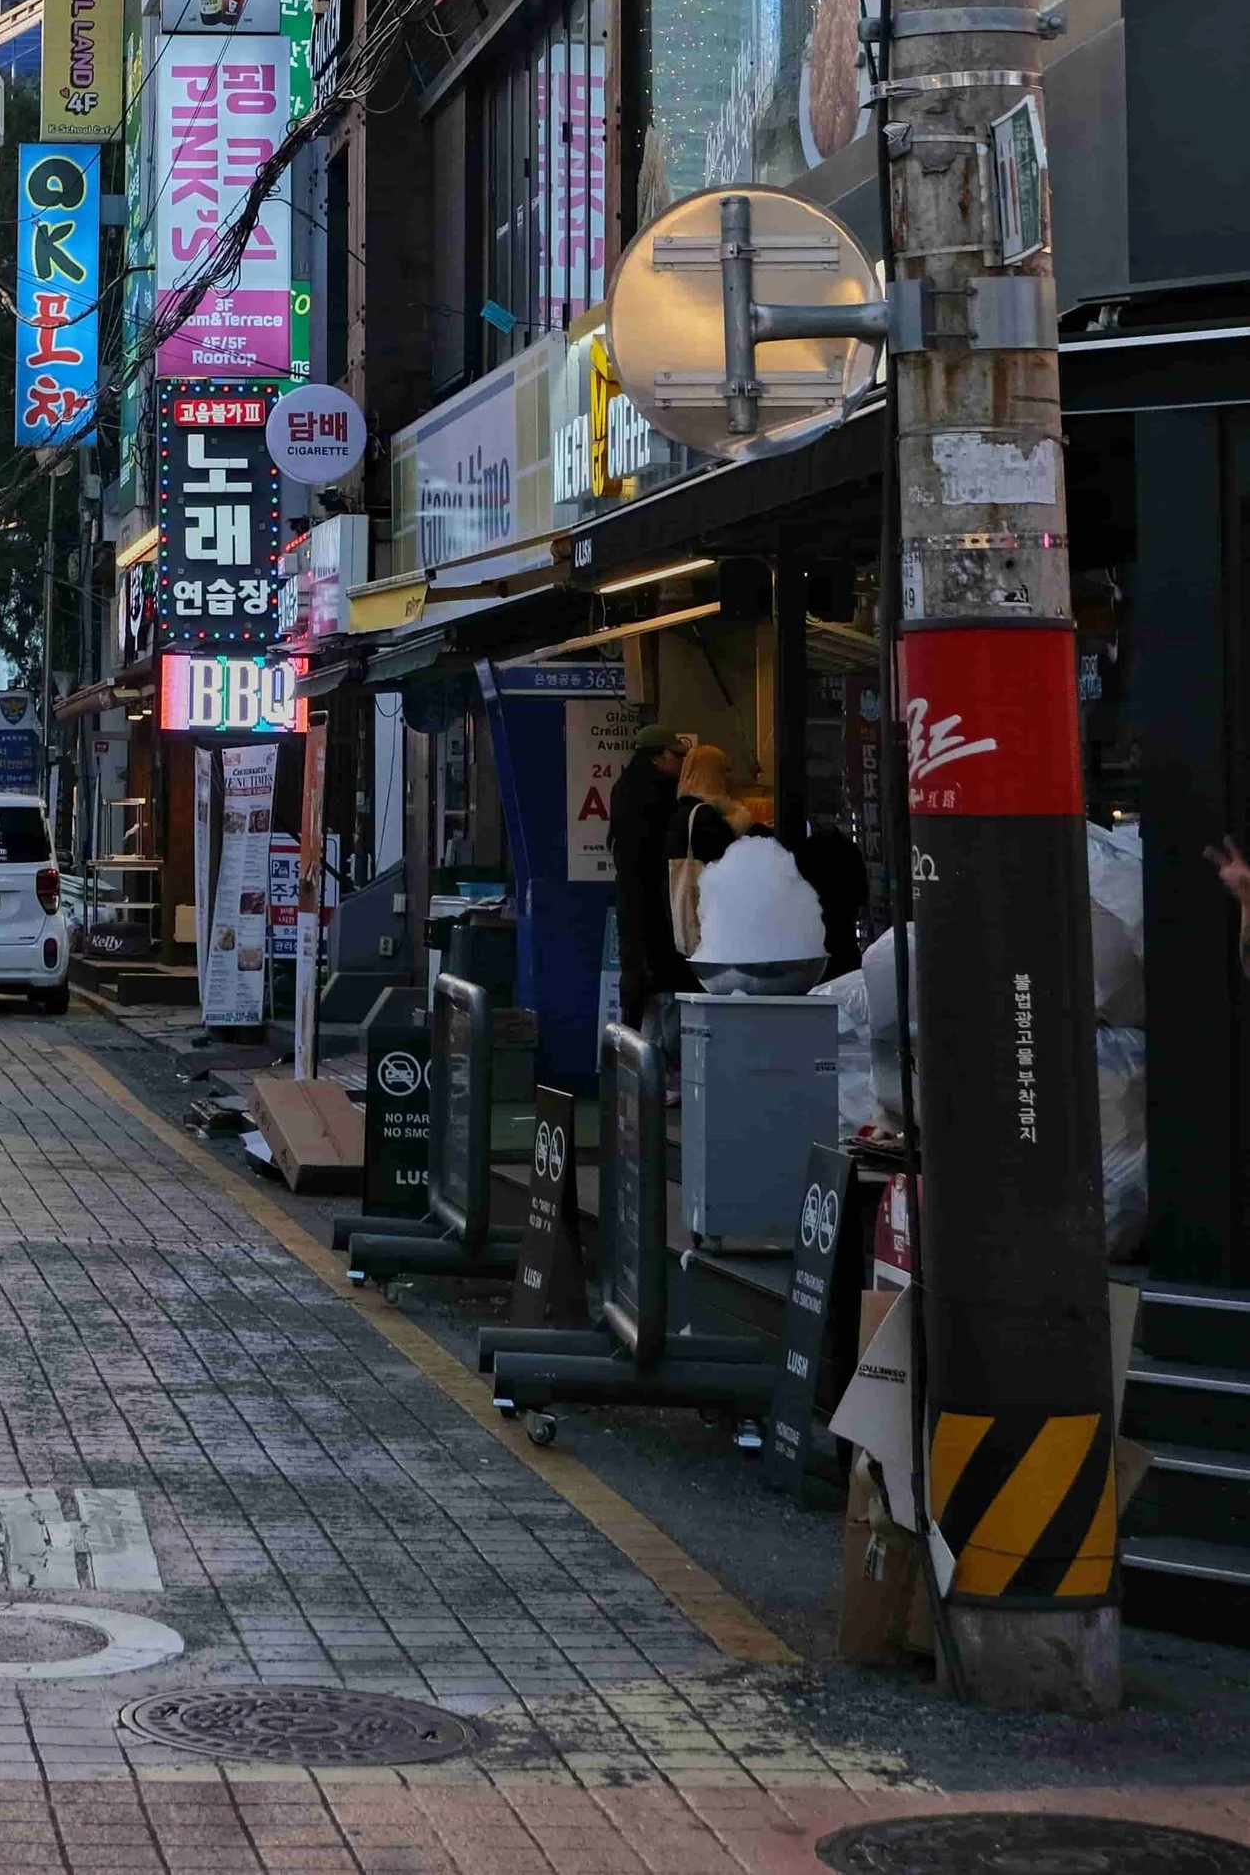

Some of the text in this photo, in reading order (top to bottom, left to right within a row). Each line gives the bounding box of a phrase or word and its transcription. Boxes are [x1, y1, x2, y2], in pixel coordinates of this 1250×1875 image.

[70, 20, 95, 88] LAND
[65, 92, 99, 115] 4F
[170, 64, 220, 263] PINK'S
[214, 298, 235, 312] 3F
[201, 336, 247, 349] 4F/5F
[192, 350, 258, 367] Rooftop
[287, 411, 349, 443] 담배
[287, 445, 350, 457] CIGARETTE
[553, 412, 590, 504] MEGA
[182, 433, 253, 566] 노래
[574, 537, 593, 569] LUSH
[173, 577, 271, 616] 연습장
[584, 669, 619, 688] 365
[188, 655, 299, 729] BBQ
[590, 725, 630, 737] Credit
[591, 764, 613, 779] 24
[91, 934, 123, 953] Kelly
[1012, 973, 1038, 1144] 불법광고물 부착금지
[385, 1112, 403, 1123] NO
[383, 1127, 401, 1138] NO
[523, 1266, 543, 1289] LUSH
[786, 1348, 810, 1380] LUSH
